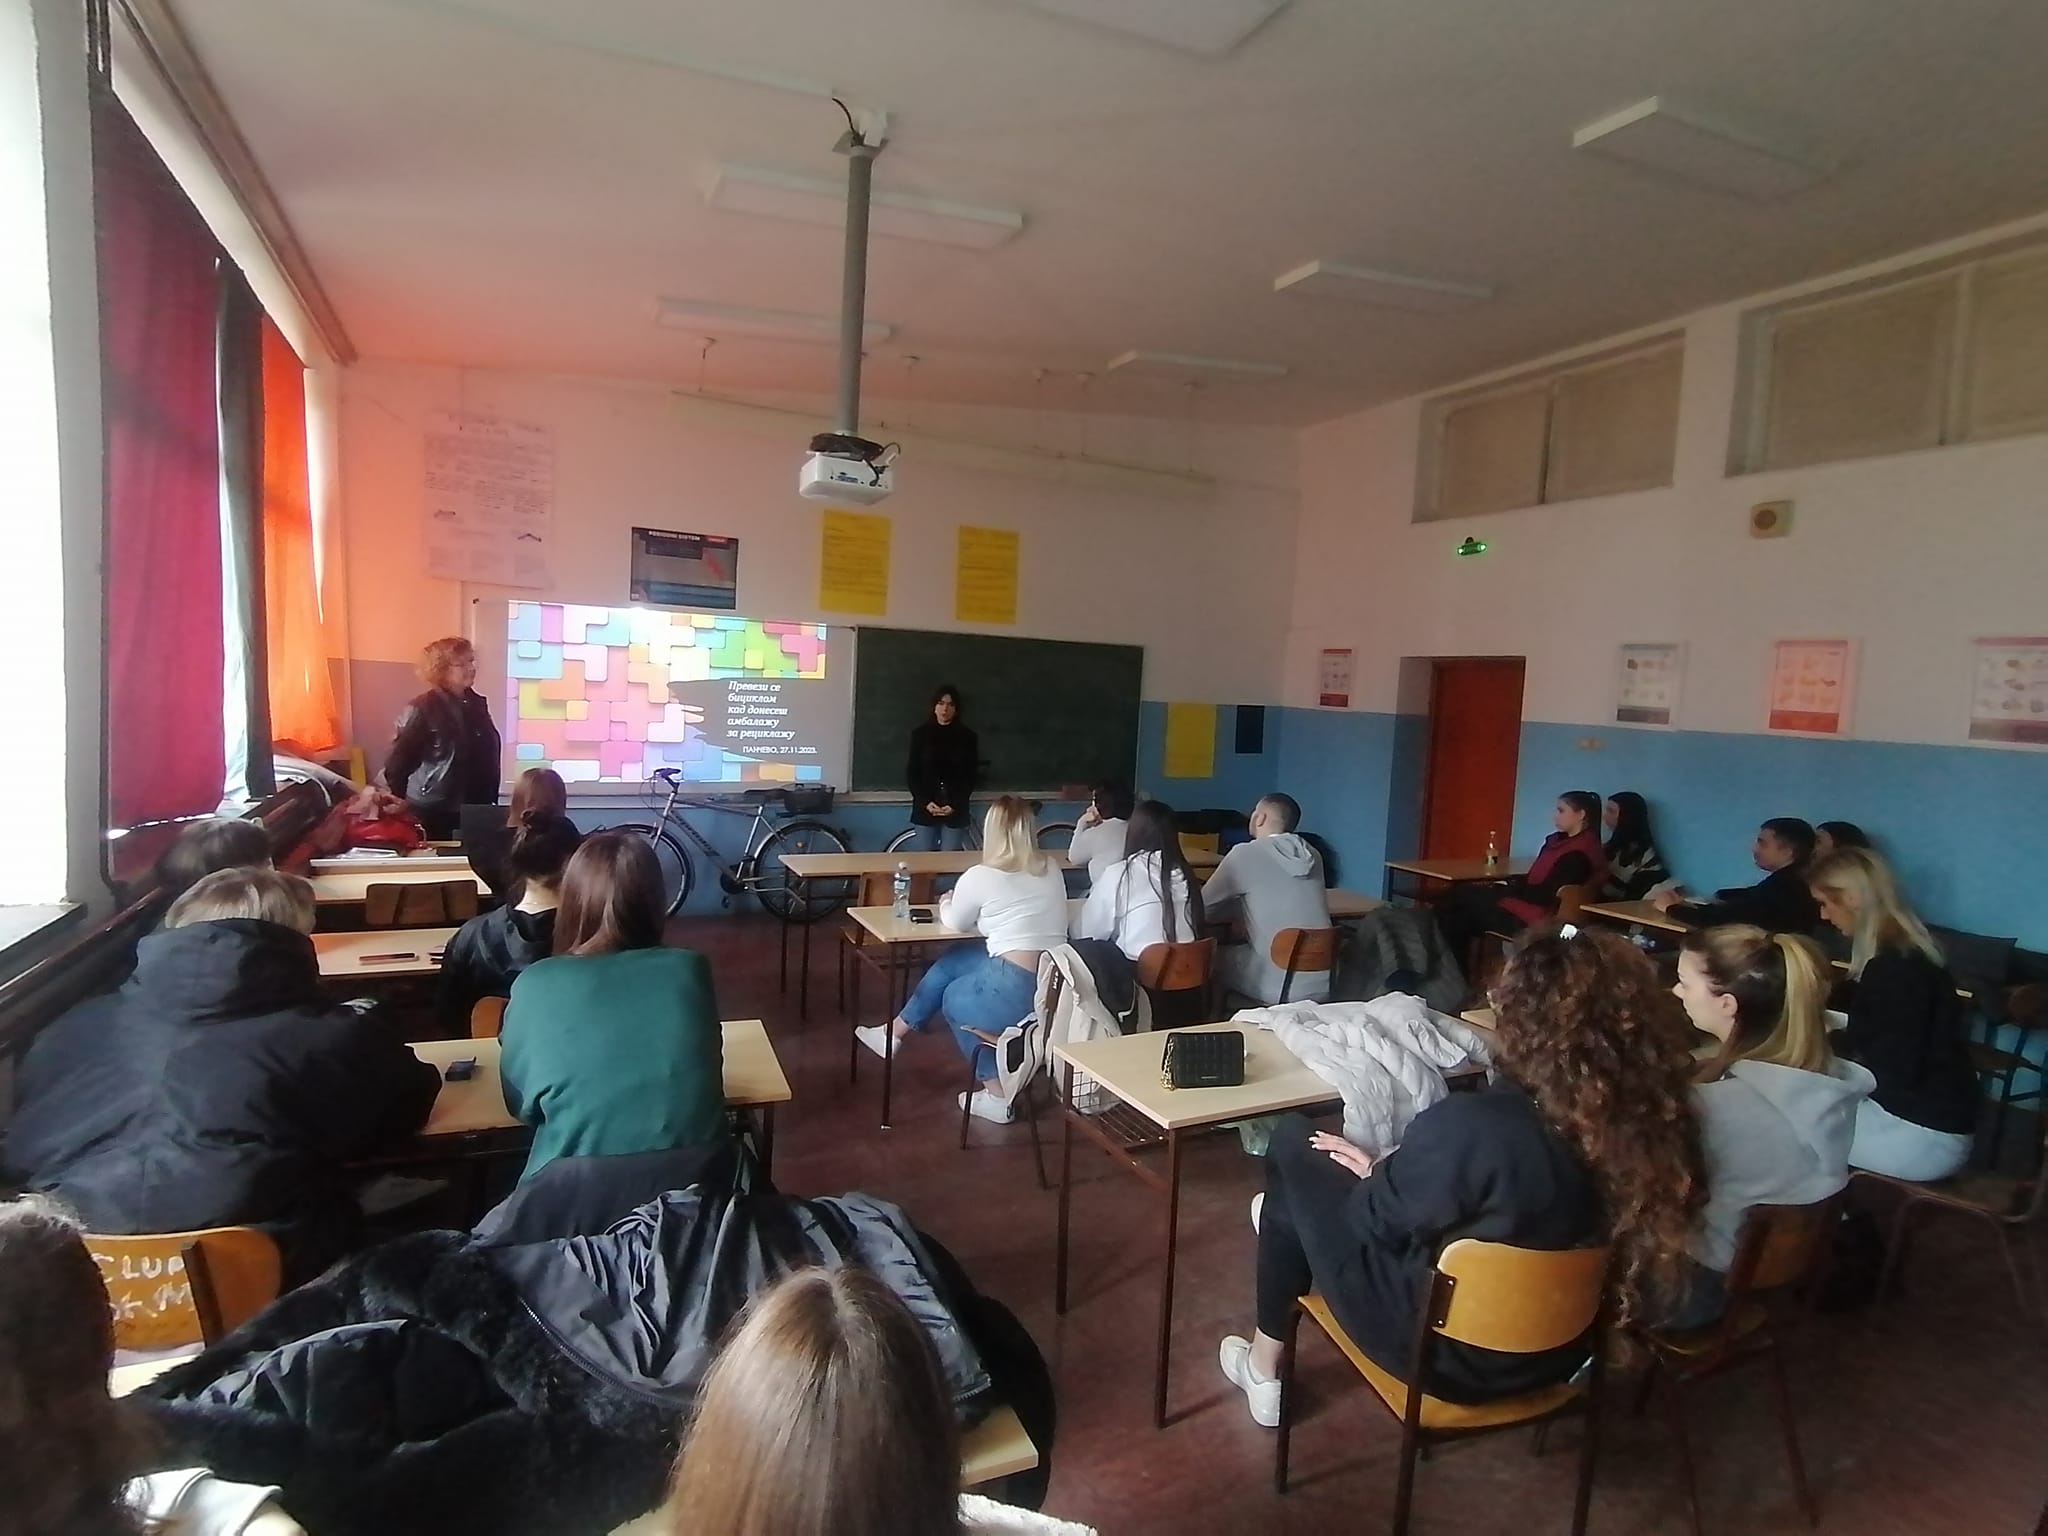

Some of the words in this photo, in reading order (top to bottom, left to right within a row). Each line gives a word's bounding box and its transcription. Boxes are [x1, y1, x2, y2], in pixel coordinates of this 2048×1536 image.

[728, 680, 769, 692] Превези
[770, 684, 781, 692] се
[727, 692, 777, 704] бициклом
[727, 704, 746, 714] кад
[747, 704, 788, 715] донесеш
[727, 716, 780, 728] амбалажу
[726, 730, 739, 738] за
[739, 730, 796, 740] рециклажу
